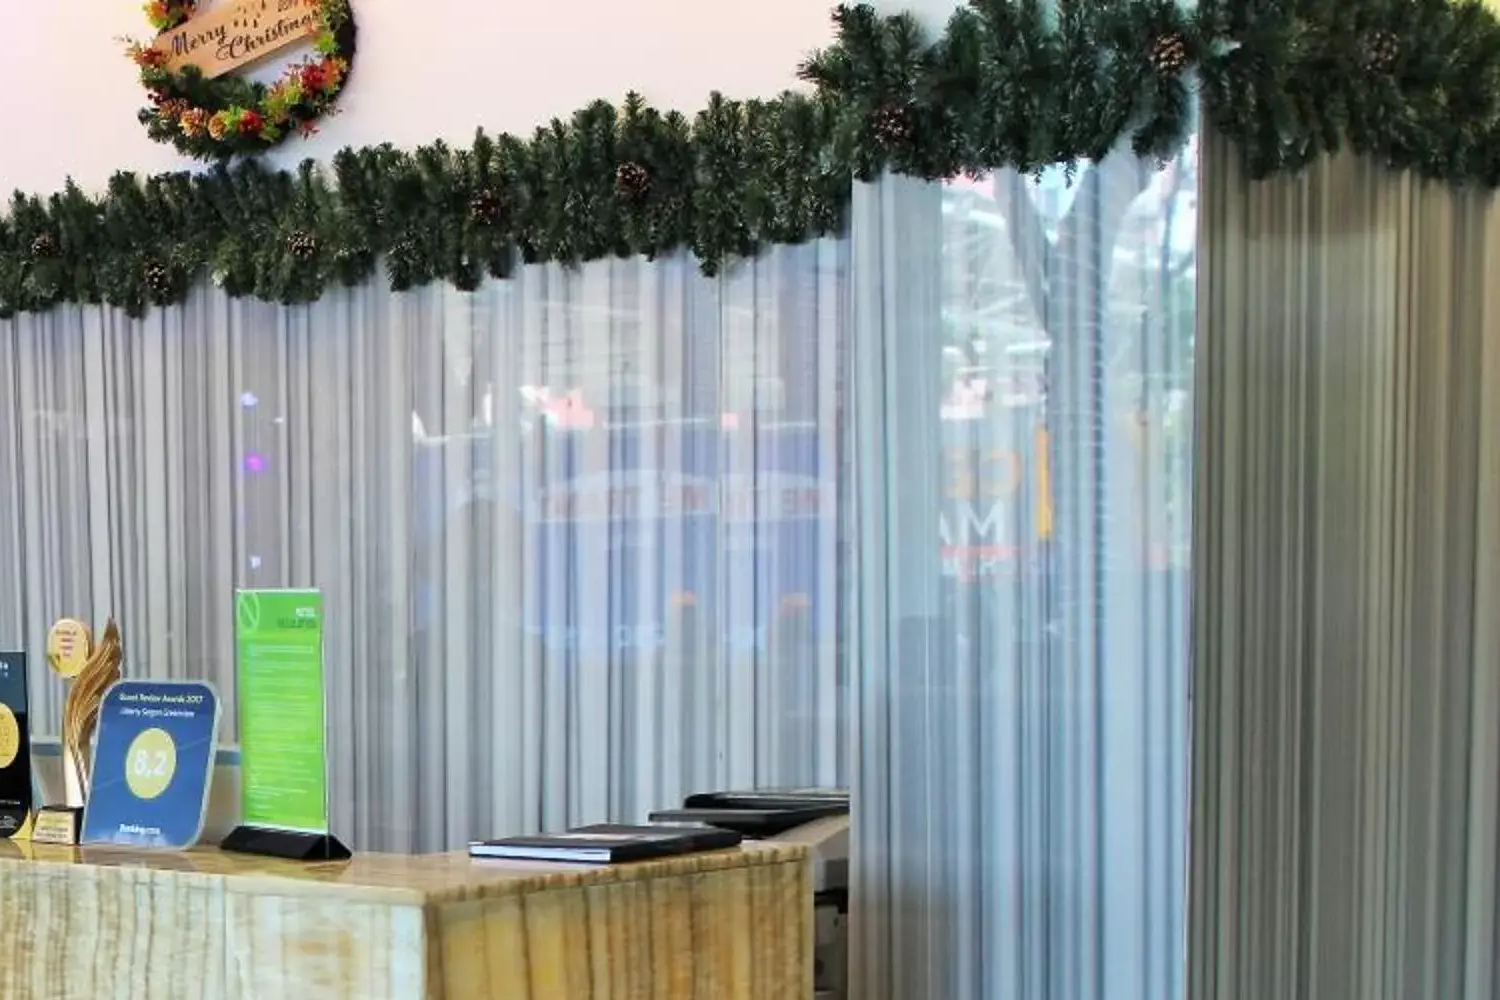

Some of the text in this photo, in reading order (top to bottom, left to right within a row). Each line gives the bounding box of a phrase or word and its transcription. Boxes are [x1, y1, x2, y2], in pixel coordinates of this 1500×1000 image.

[170, 24, 227, 57] Merry
[216, 9, 320, 60] Christmas
[162, 694, 185, 703] Awards
